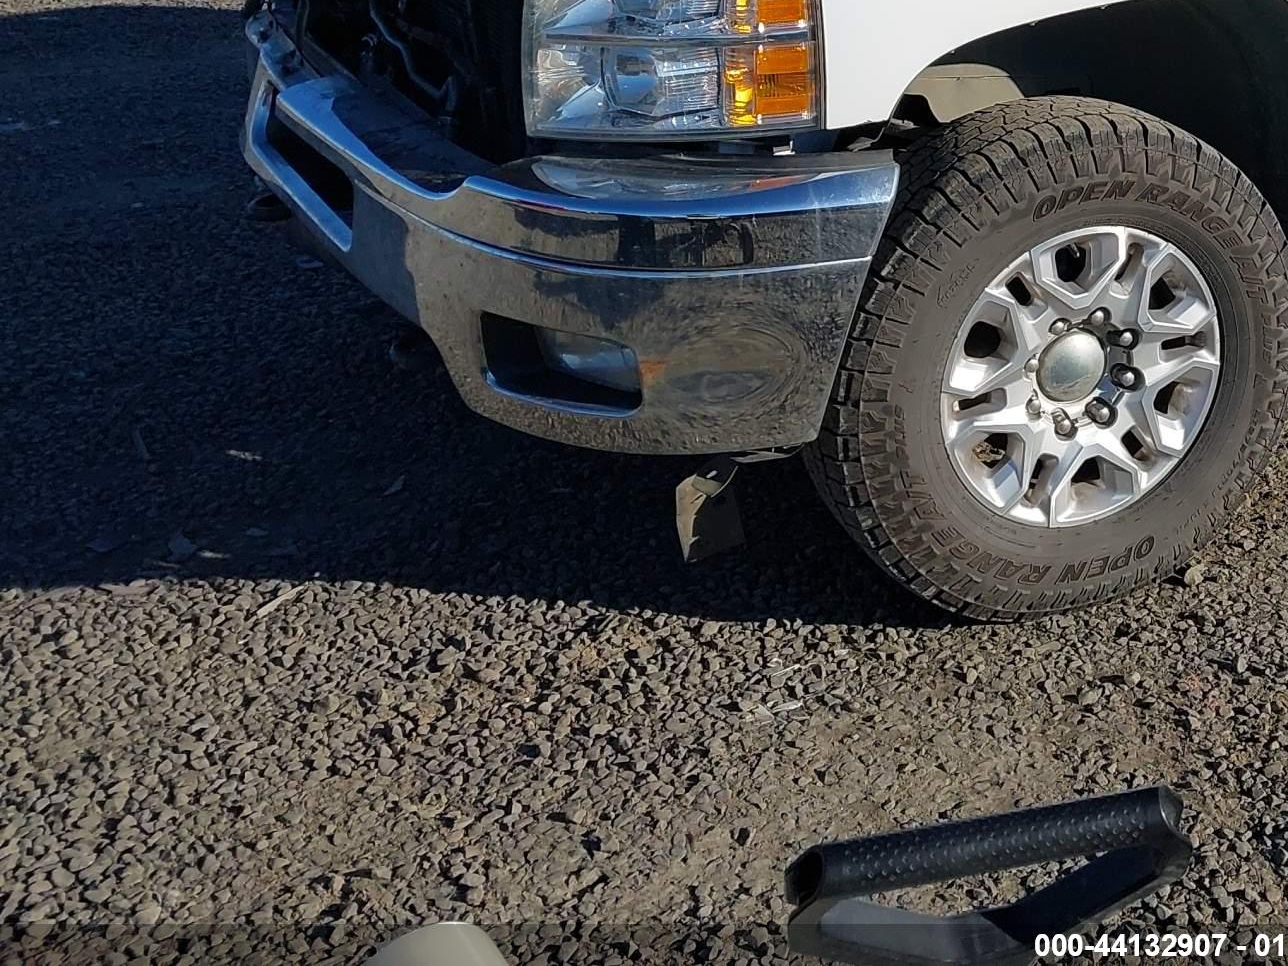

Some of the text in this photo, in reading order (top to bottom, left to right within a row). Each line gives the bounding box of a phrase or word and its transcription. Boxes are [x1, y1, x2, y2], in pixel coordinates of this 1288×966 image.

[1033, 180, 1135, 222] OPEN
[1135, 183, 1244, 250] RANGE
[931, 526, 1053, 585] RANGE
[1055, 535, 1156, 585] OPEN
